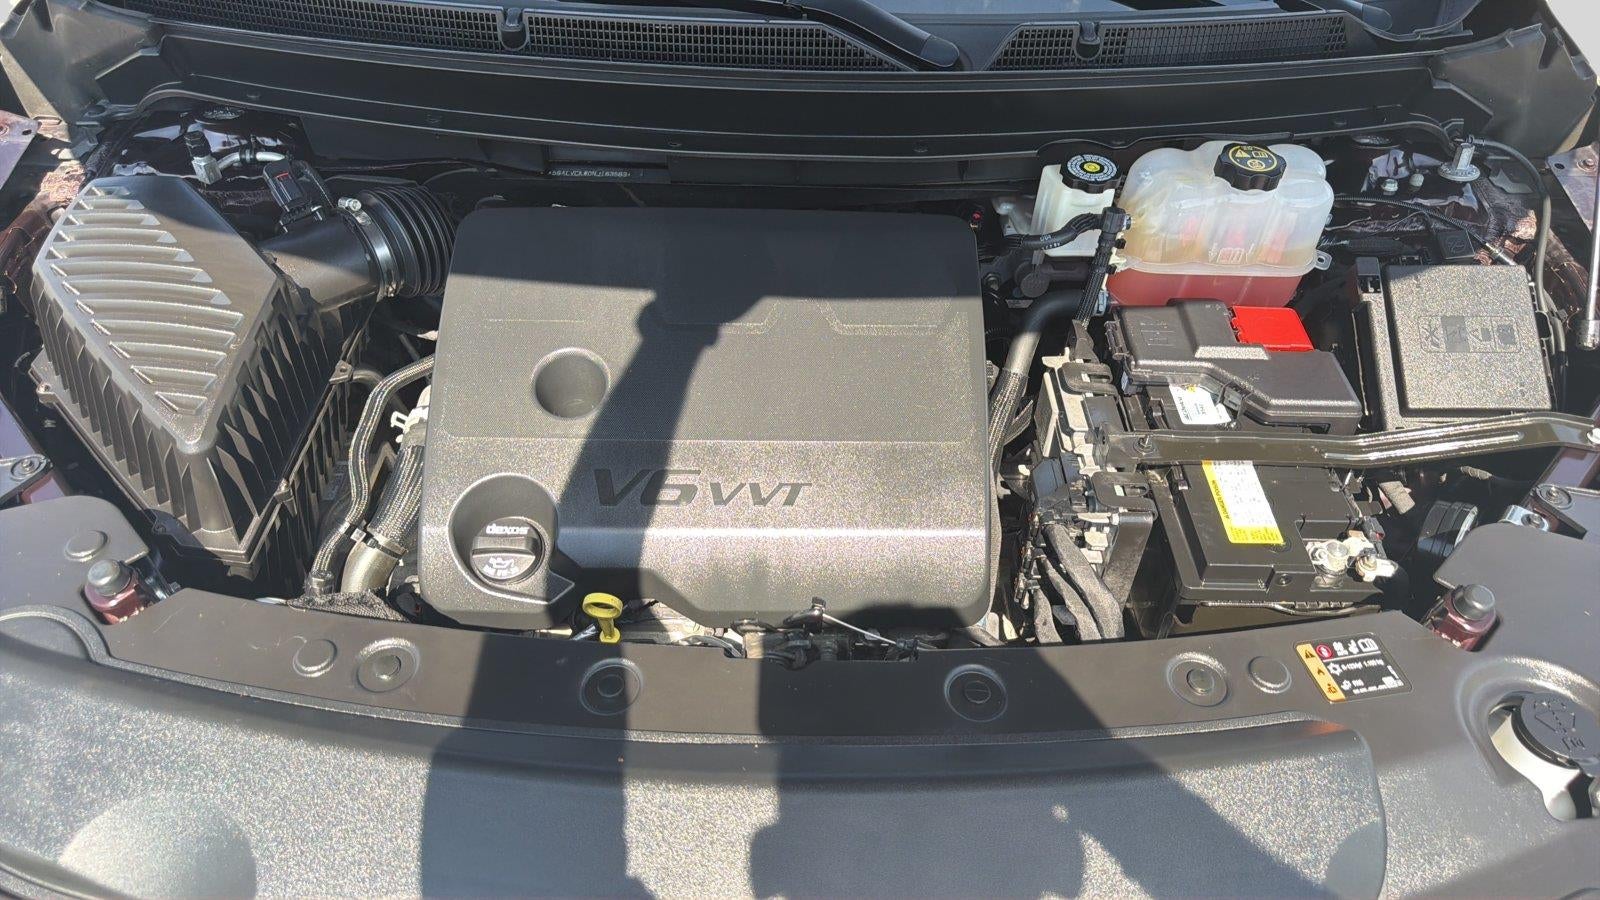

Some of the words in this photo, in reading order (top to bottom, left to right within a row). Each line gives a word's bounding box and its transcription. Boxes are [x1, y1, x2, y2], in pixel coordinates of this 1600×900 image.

[594, 469, 701, 507] V6
[710, 482, 812, 507] VVT
[485, 523, 530, 535] dexos
